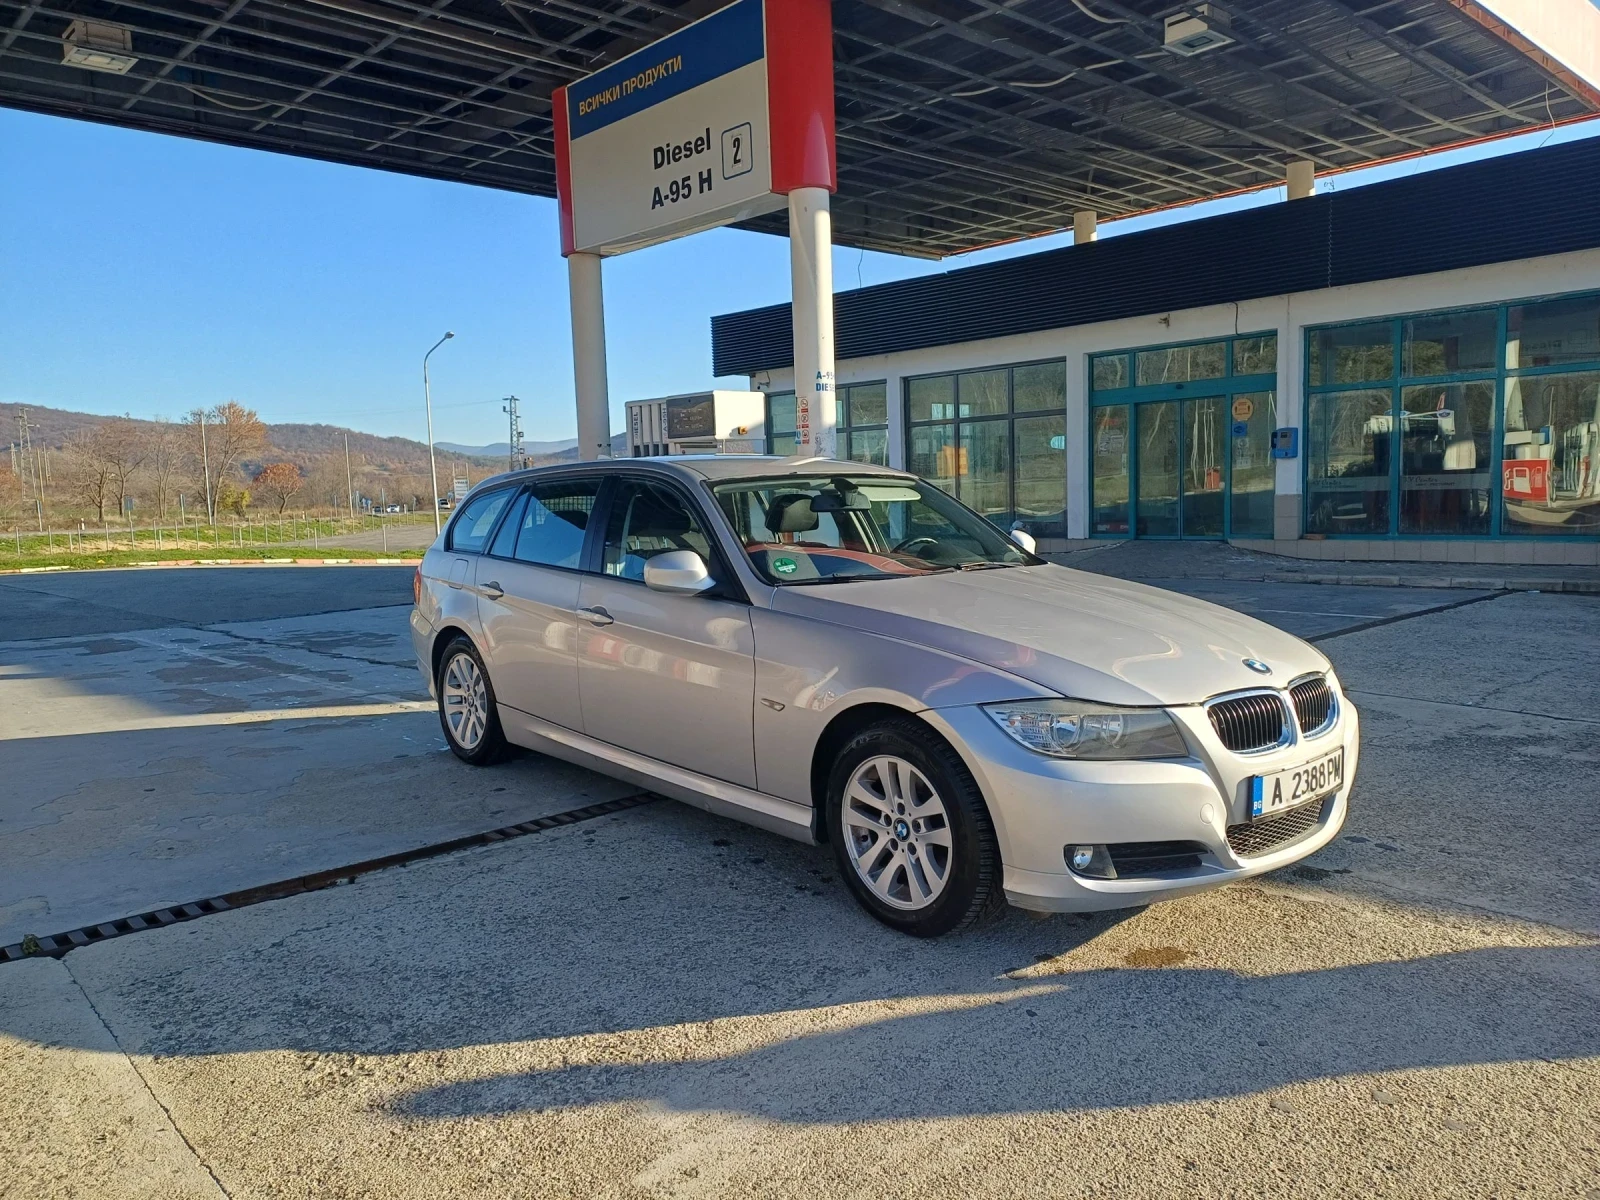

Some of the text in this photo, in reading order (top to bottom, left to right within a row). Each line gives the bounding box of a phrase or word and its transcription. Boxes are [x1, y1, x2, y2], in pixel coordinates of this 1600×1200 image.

[579, 55, 682, 116] ВСИЧКИ ПРОДУКТИ
[653, 128, 711, 170] Diesel
[732, 137, 742, 165] 2
[651, 168, 713, 210] A-95 H
[1253, 800, 1262, 810] BG
[1271, 777, 1283, 806] A
[1291, 763, 1326, 800] 2388
